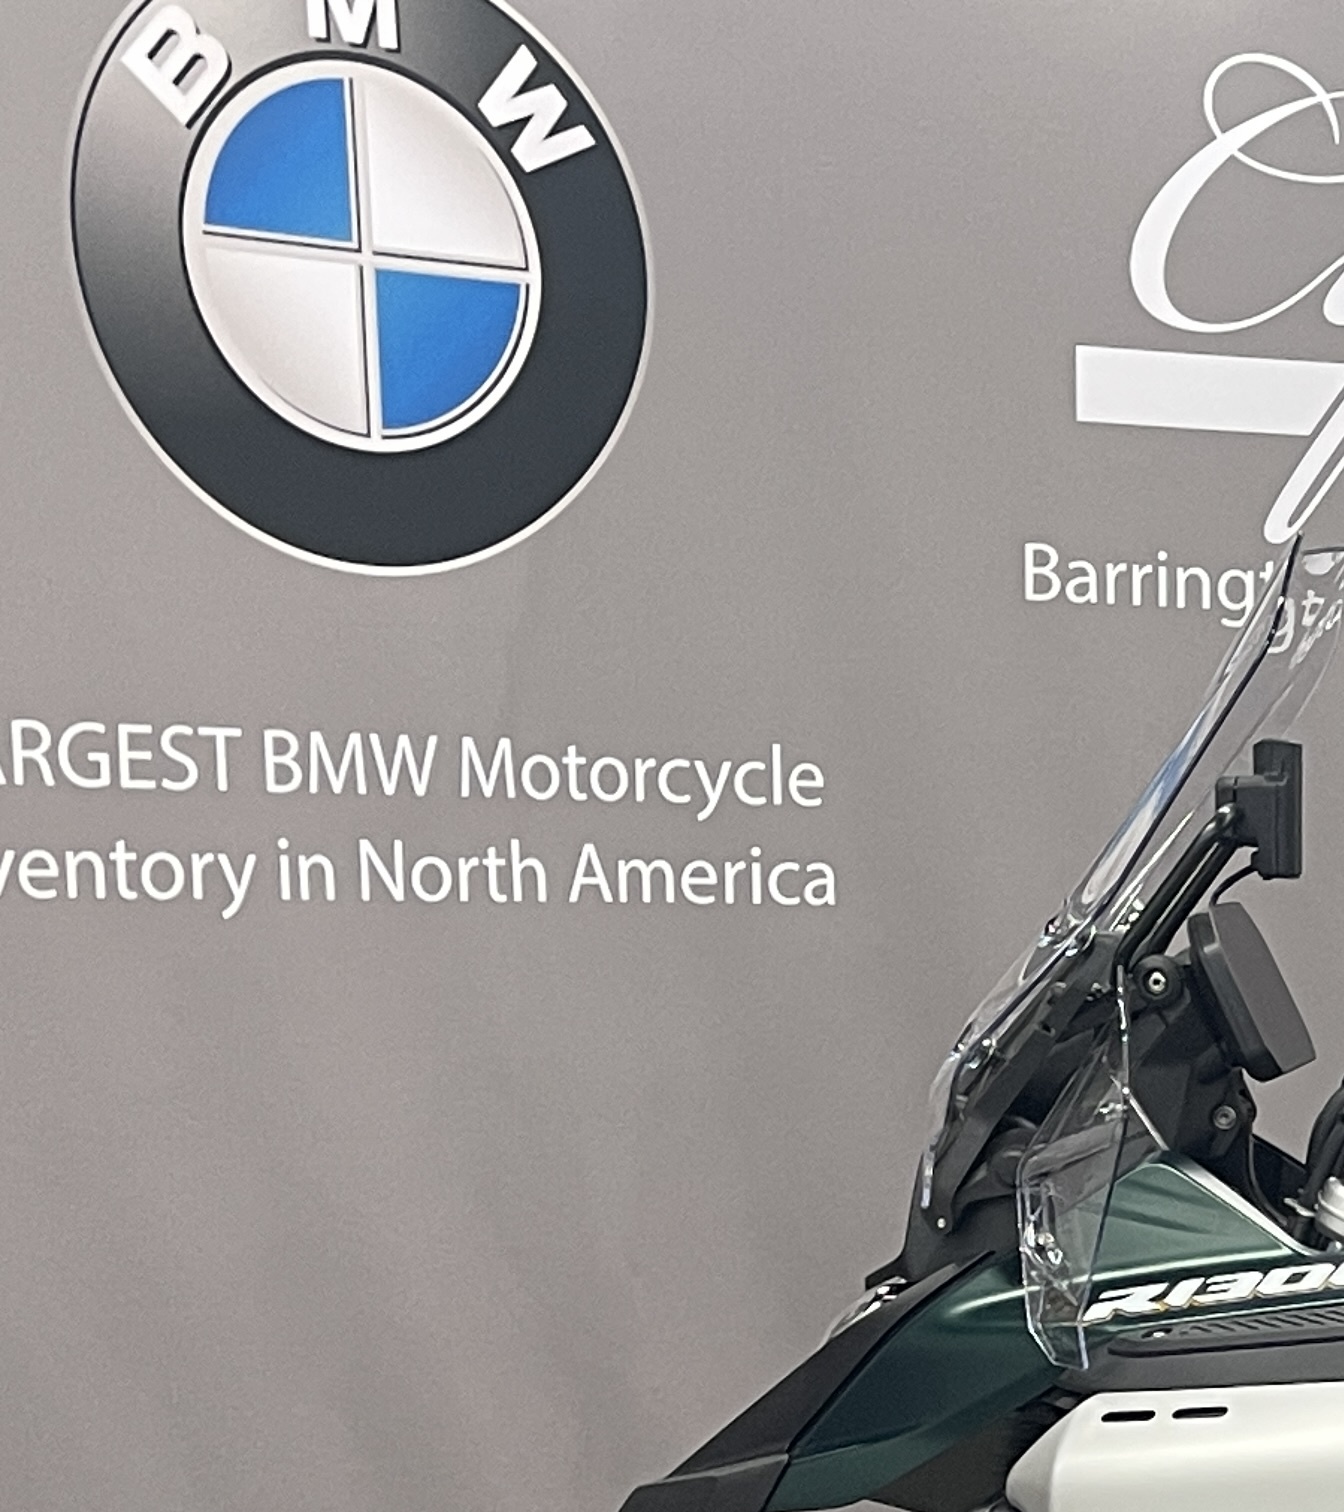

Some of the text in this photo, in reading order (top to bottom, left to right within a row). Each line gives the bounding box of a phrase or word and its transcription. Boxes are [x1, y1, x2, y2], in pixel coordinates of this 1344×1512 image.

[0, 719, 825, 821] RGEST BMW Motorcycle
[277, 837, 337, 901] in
[359, 838, 548, 904] North
[569, 842, 838, 907] America
